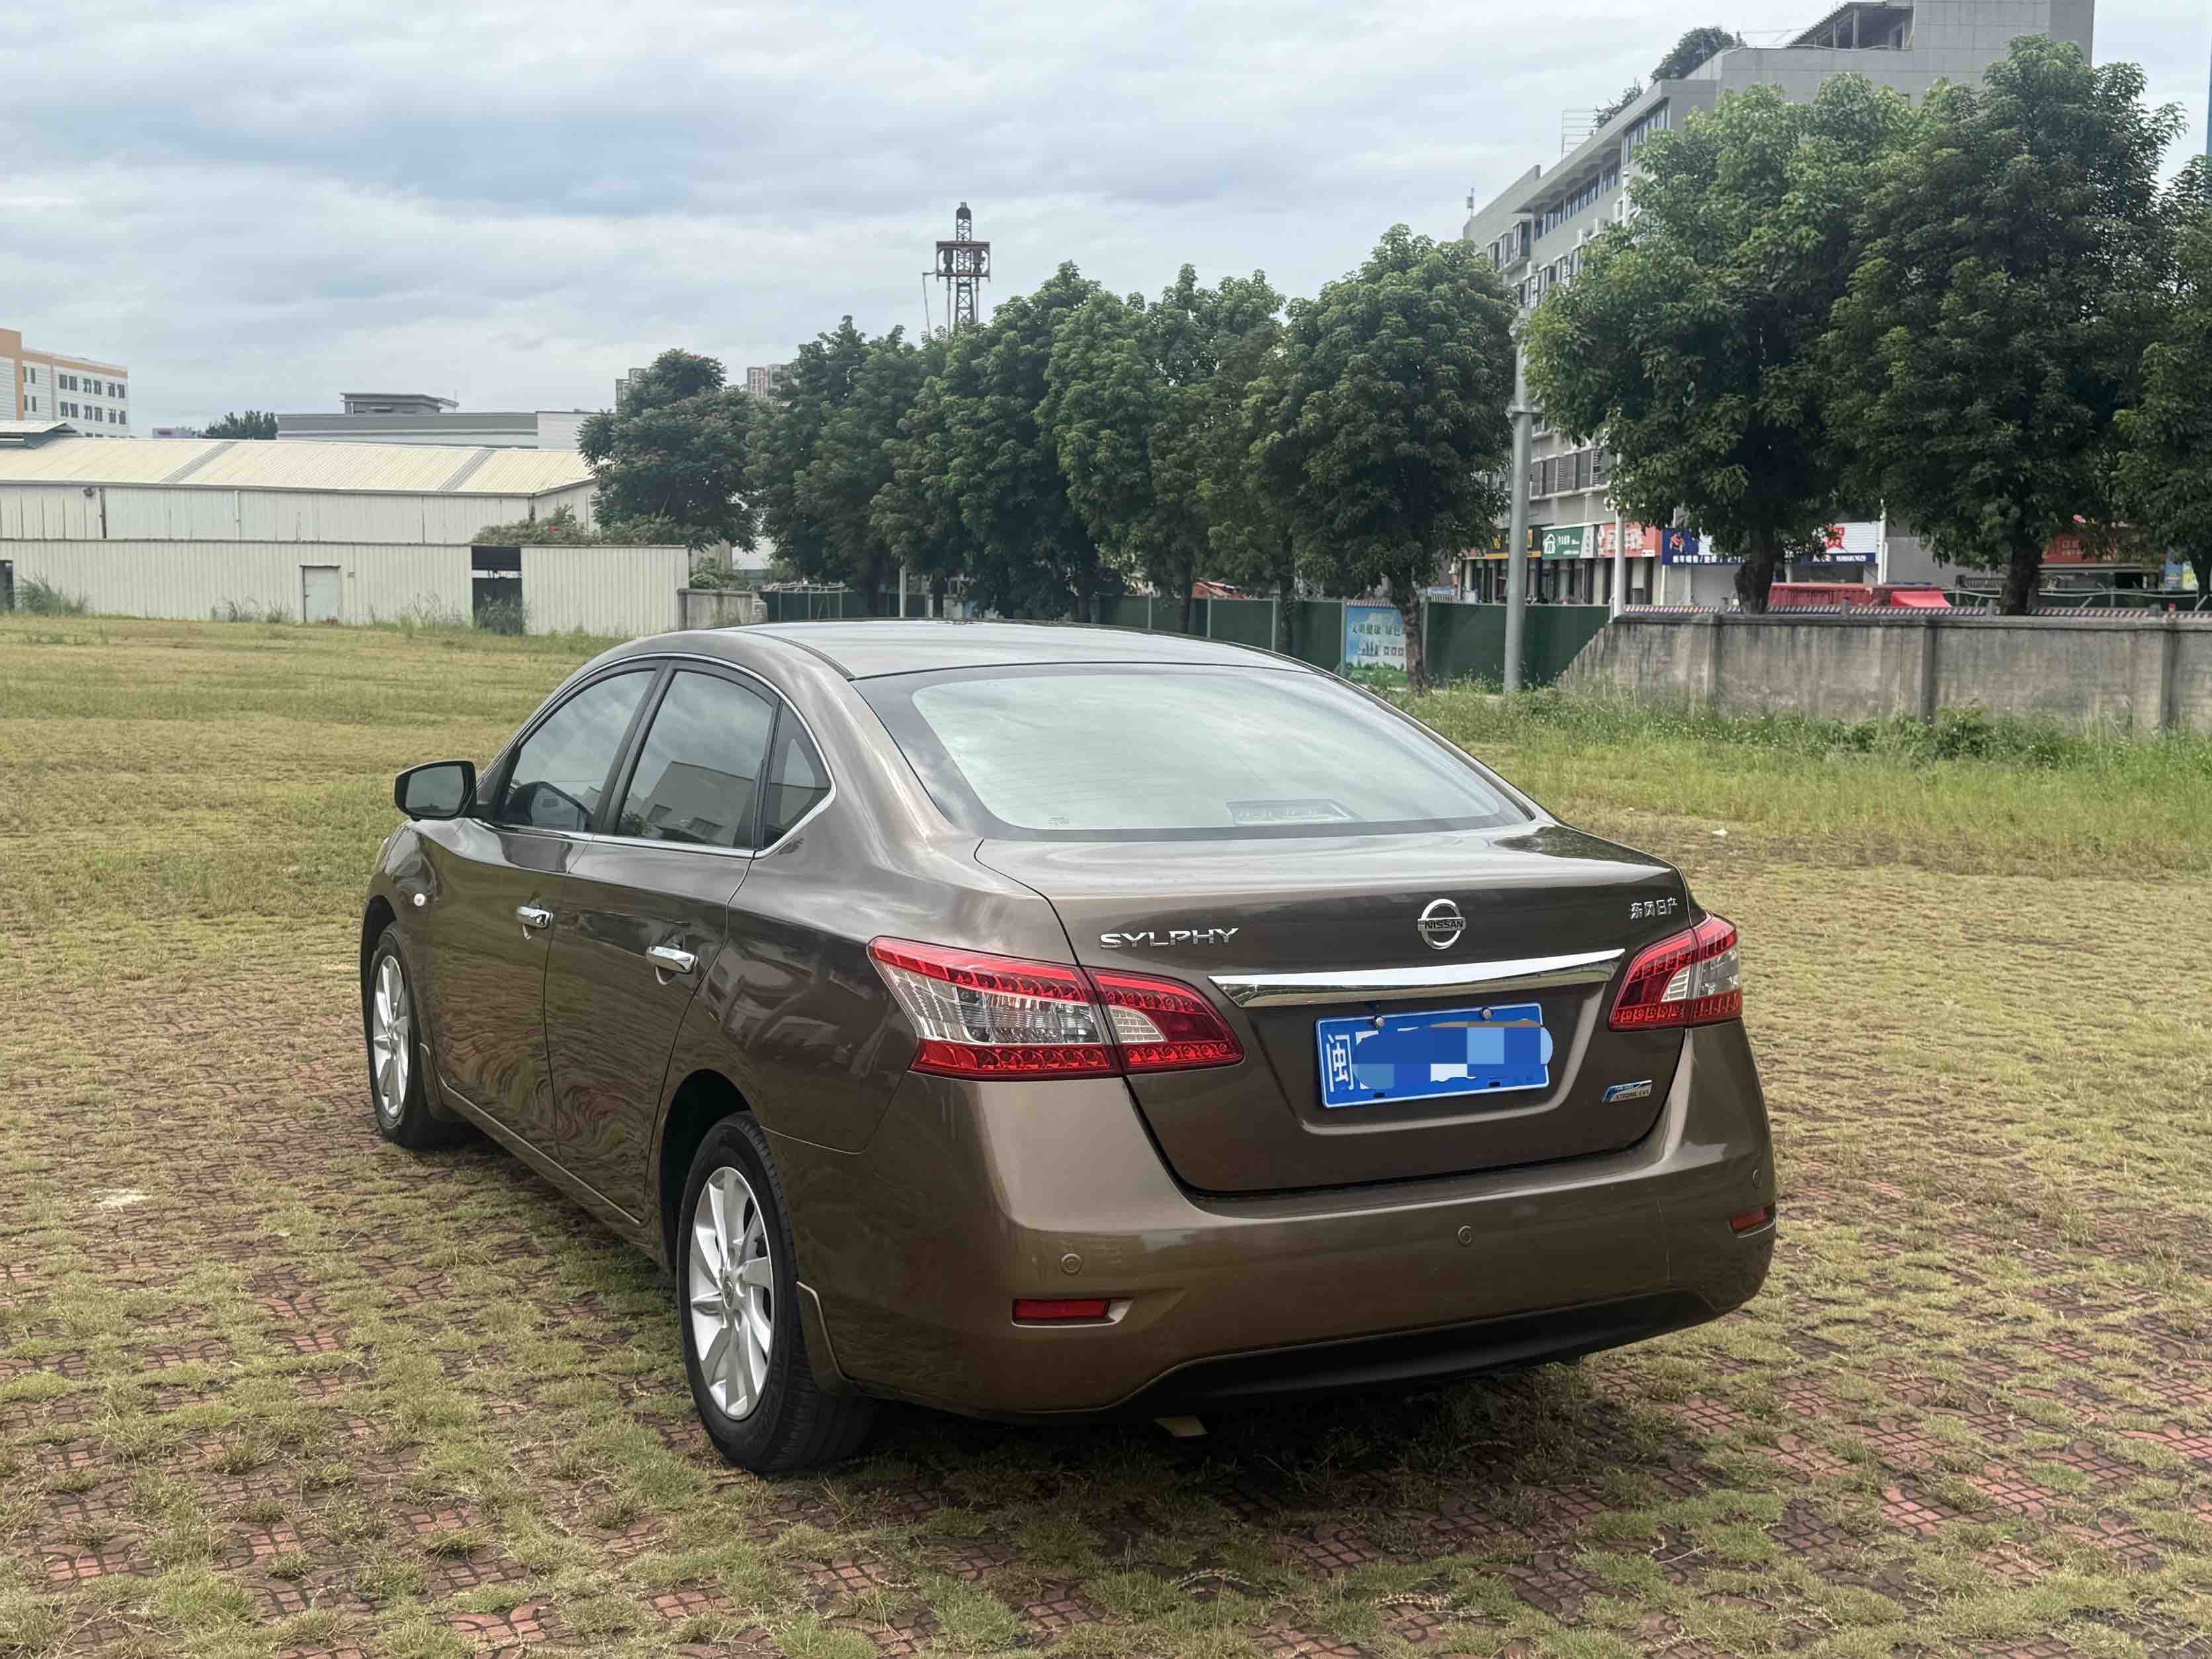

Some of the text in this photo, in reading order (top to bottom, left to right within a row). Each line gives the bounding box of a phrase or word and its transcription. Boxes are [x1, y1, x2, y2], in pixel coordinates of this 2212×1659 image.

[1631, 897, 1678, 920] 东风日产
[1424, 920, 1463, 929] NISSAN
[1100, 927, 1239, 949] SYLPHY
[1325, 1034, 1355, 1092] 闽
